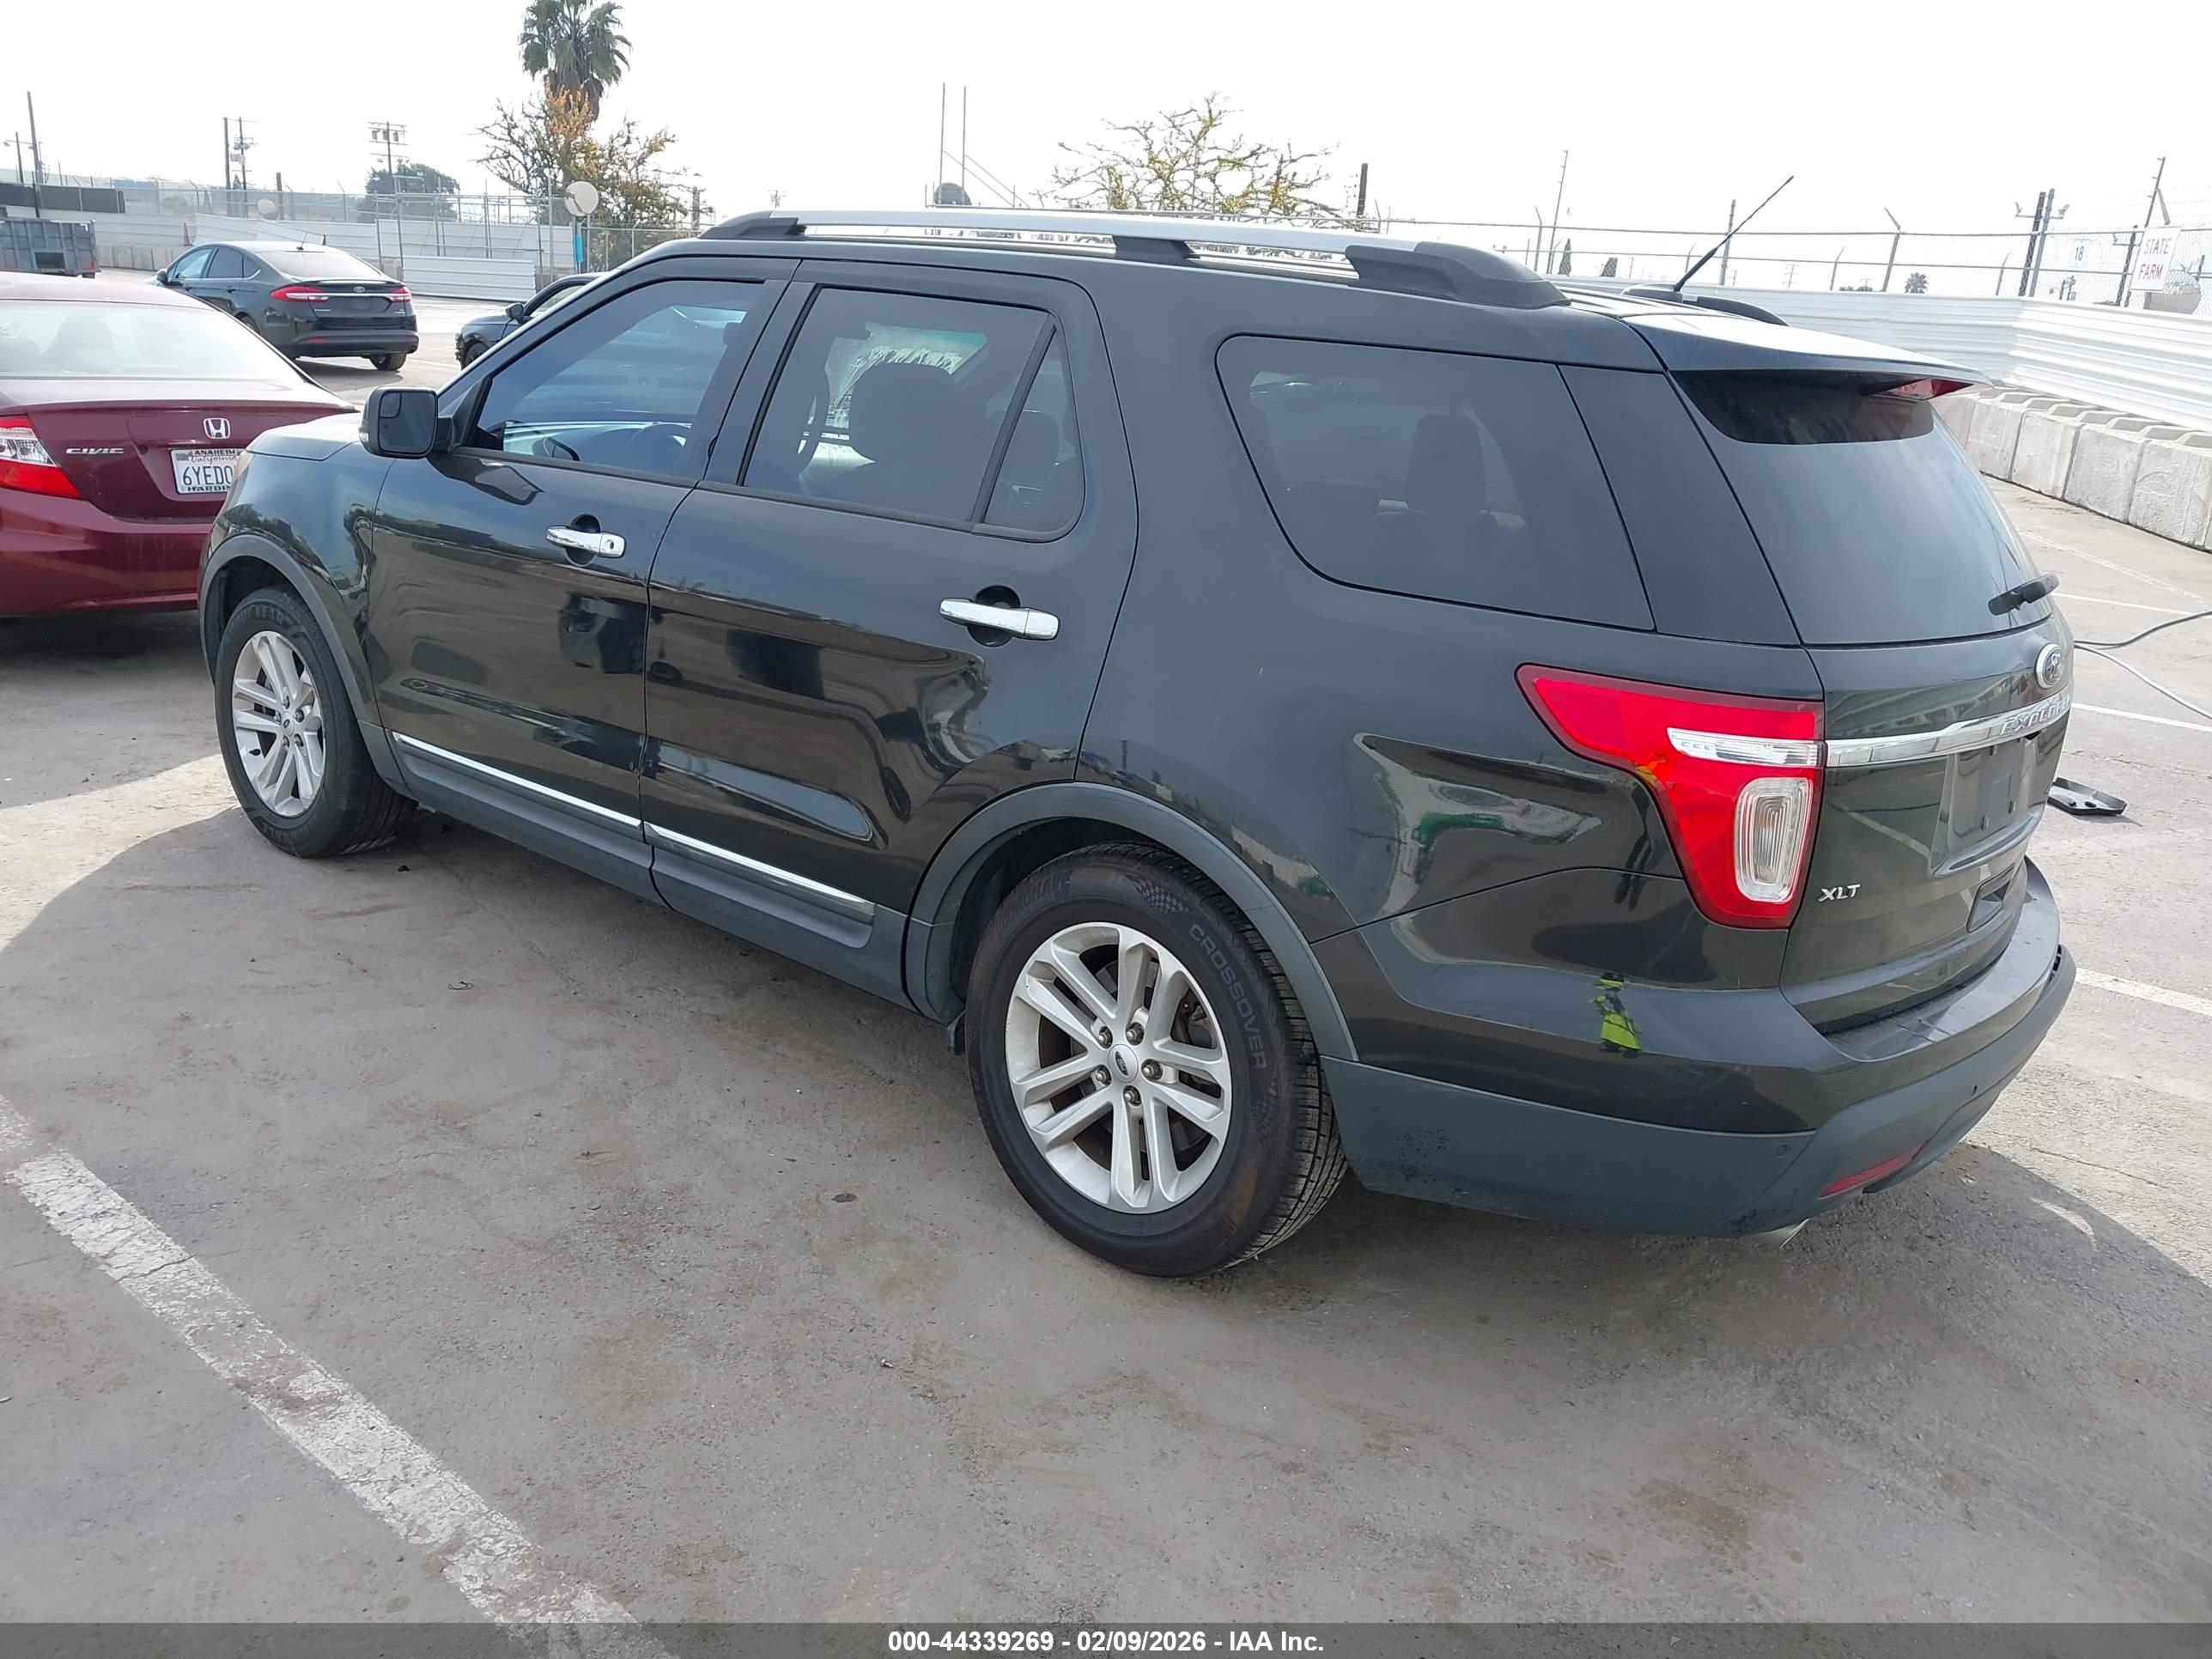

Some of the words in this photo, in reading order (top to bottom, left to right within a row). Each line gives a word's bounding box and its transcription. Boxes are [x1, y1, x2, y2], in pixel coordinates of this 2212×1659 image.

[2075, 246, 2085, 261] 18
[2144, 238, 2172, 255] STATE
[2138, 264, 2164, 281] FARM
[1817, 884, 1862, 902] XLT
[1188, 922, 1267, 1070] CROSSOVER
